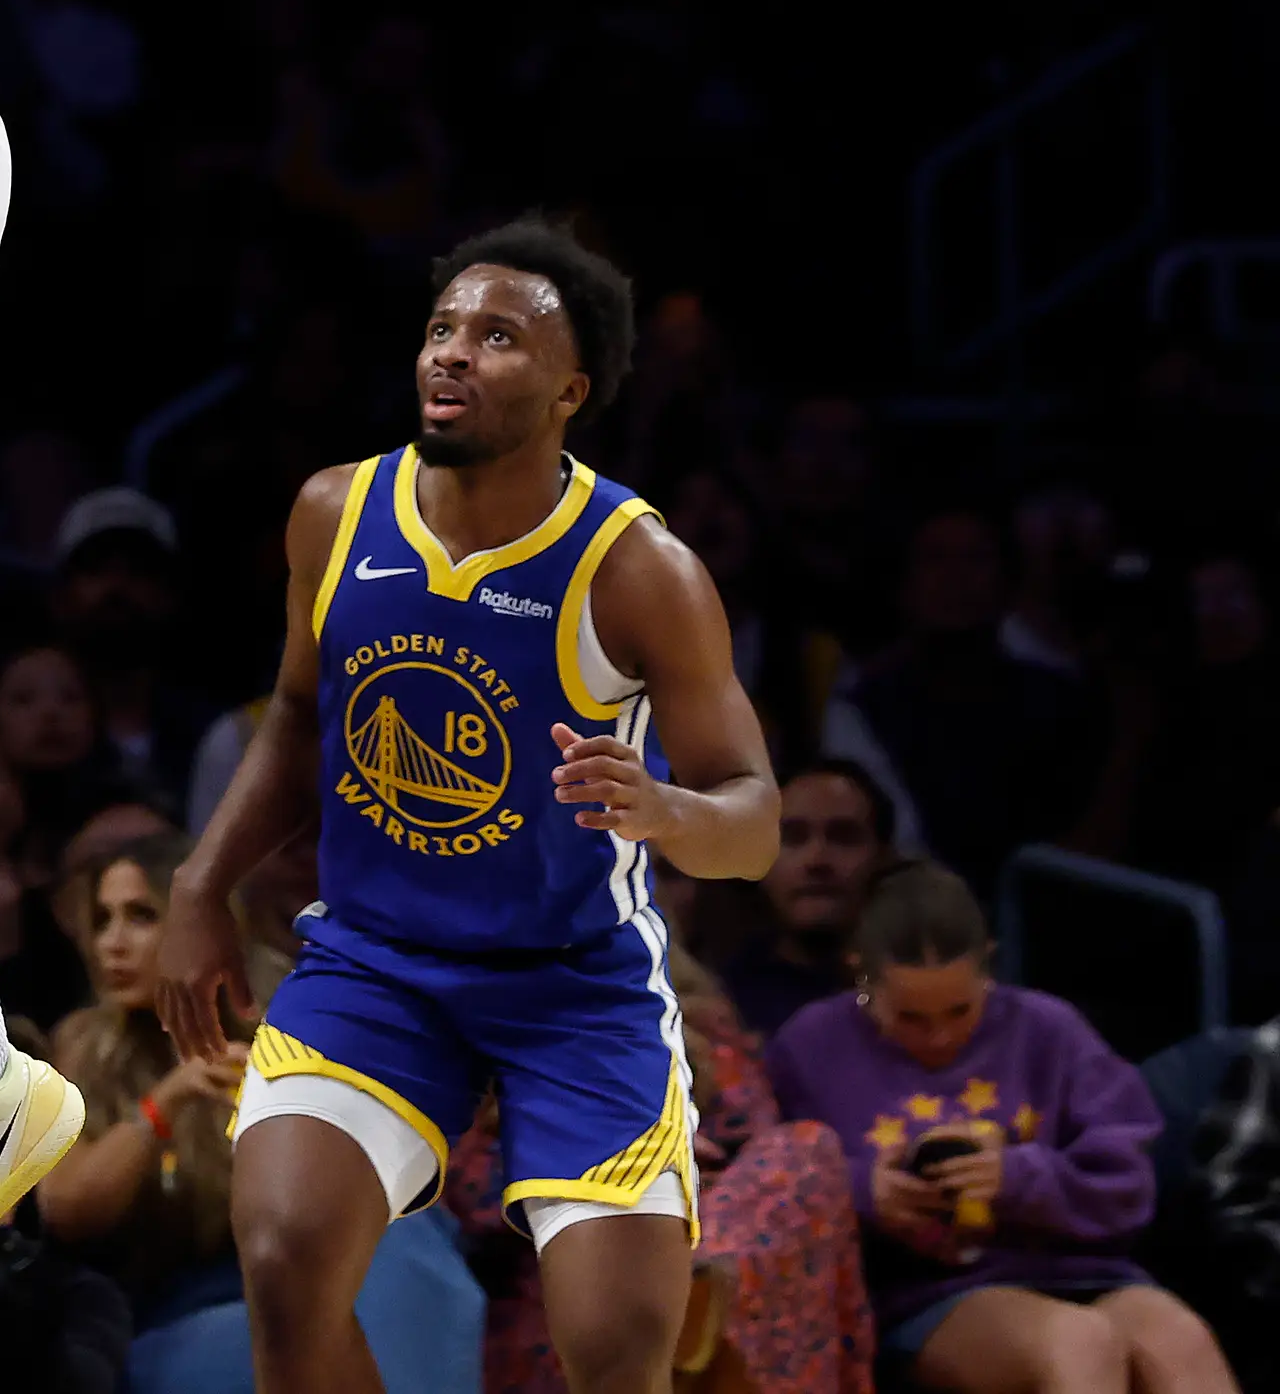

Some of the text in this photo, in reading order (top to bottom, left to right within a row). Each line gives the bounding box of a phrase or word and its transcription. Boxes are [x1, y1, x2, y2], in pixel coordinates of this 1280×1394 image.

[478, 587, 553, 619] Rakuten
[344, 634, 521, 713] GOLDEN STATE
[444, 711, 489, 757] 18
[335, 770, 525, 857] WARRIORS
